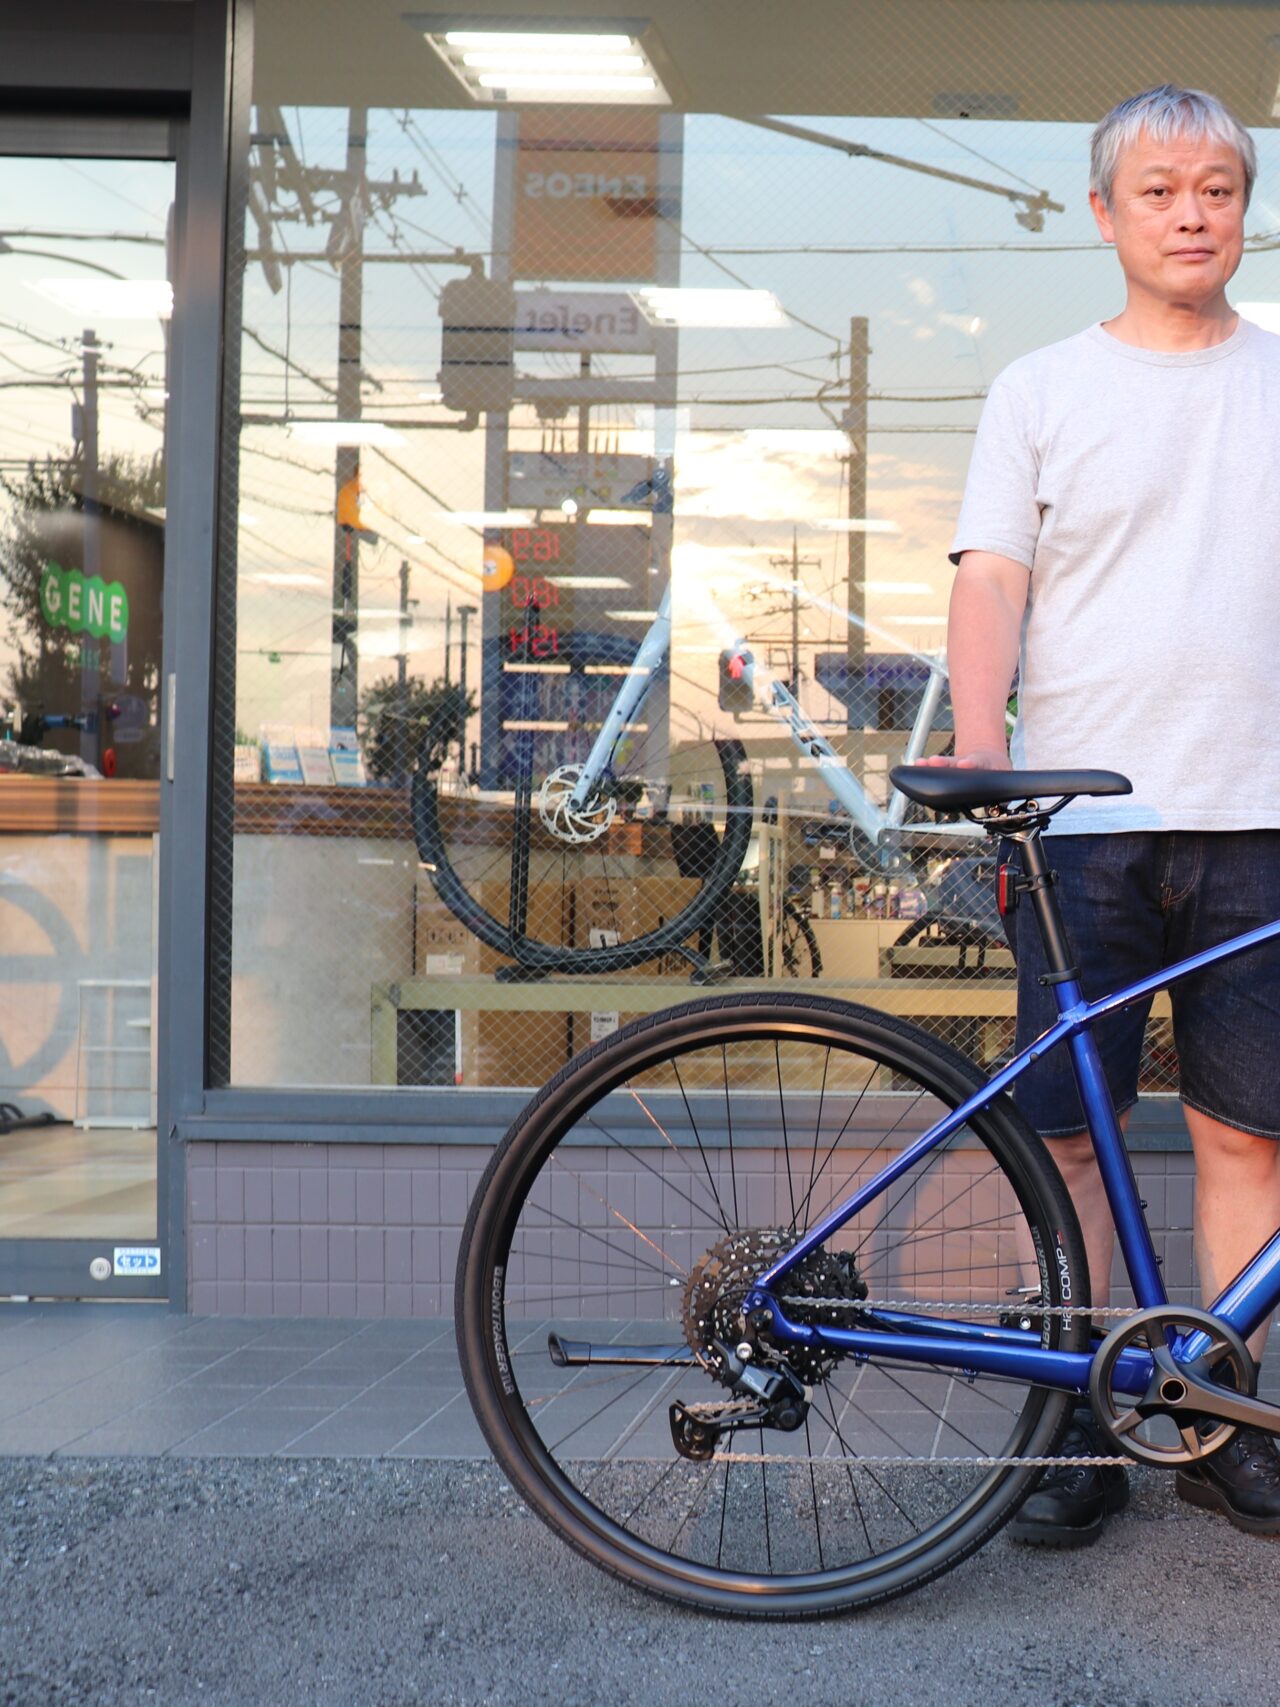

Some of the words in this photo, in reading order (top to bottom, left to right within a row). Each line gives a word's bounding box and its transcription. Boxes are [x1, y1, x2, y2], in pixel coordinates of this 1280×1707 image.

[45, 575, 123, 632] GENE
[1056, 1247, 1073, 1300] COMP
[492, 1277, 508, 1373] BONTRAGER
